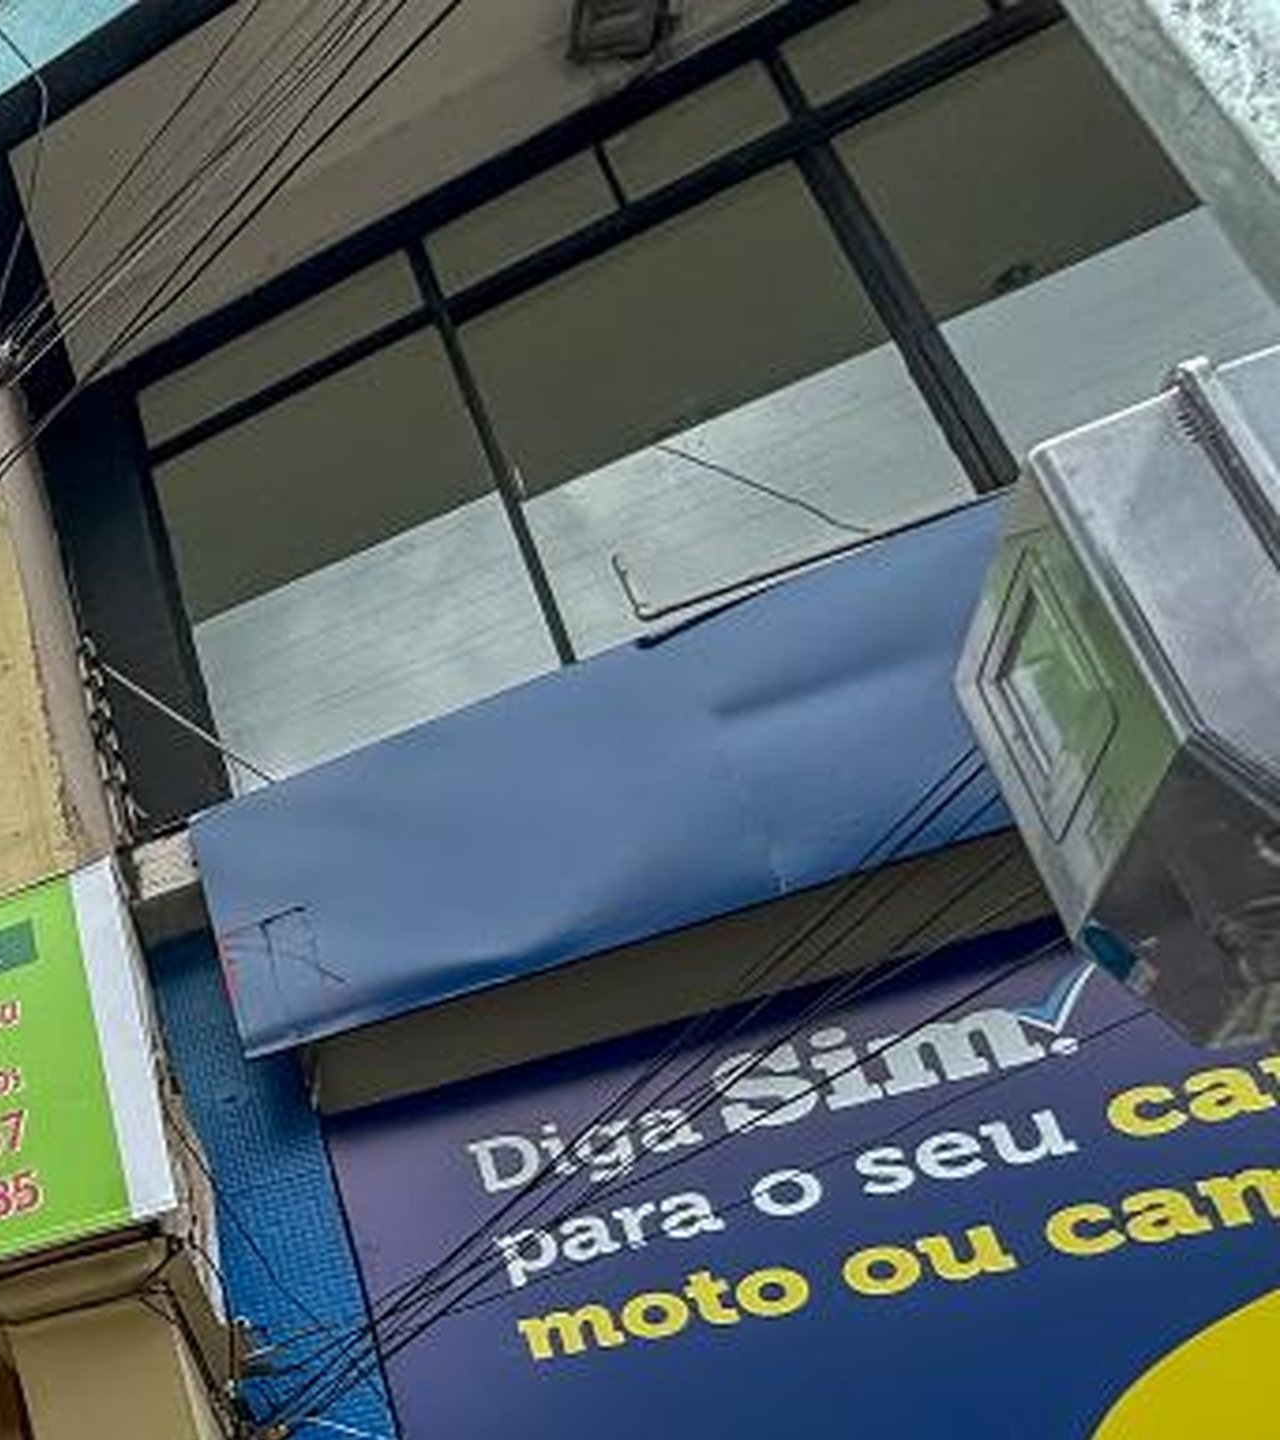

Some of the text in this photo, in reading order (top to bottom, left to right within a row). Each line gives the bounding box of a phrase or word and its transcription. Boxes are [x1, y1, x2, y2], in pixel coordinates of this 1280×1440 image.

[467, 1106, 704, 1193] Diga
[495, 1190, 726, 1287] para
[750, 1167, 824, 1217] o
[855, 1107, 1079, 1195] seu
[518, 1266, 810, 1360] moto
[842, 1223, 1018, 1296] ou
